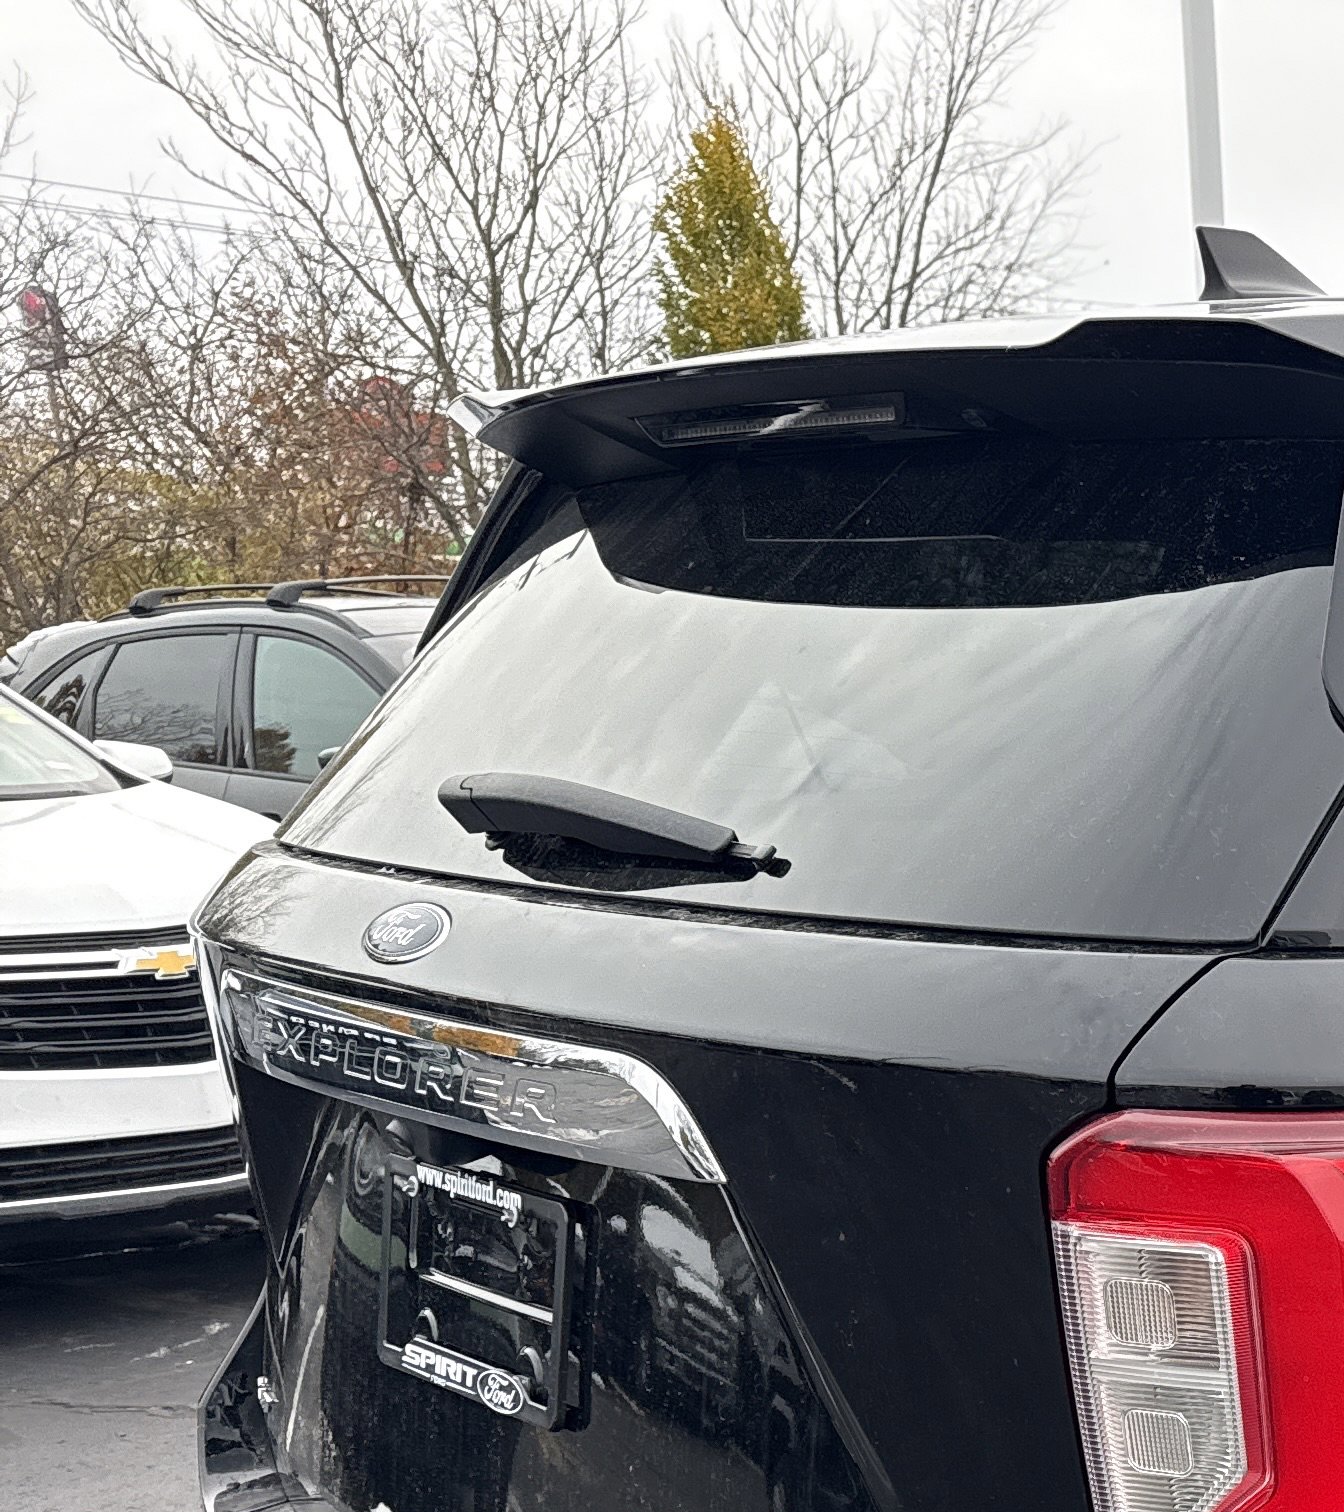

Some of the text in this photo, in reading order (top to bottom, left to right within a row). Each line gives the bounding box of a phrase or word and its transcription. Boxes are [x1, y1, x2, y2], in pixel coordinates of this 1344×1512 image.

[372, 909, 427, 946] Ford
[252, 1012, 558, 1124] EXPLORER
[416, 1164, 522, 1211] www.spiritford.com
[402, 1343, 516, 1409] SPIRIT Ford
